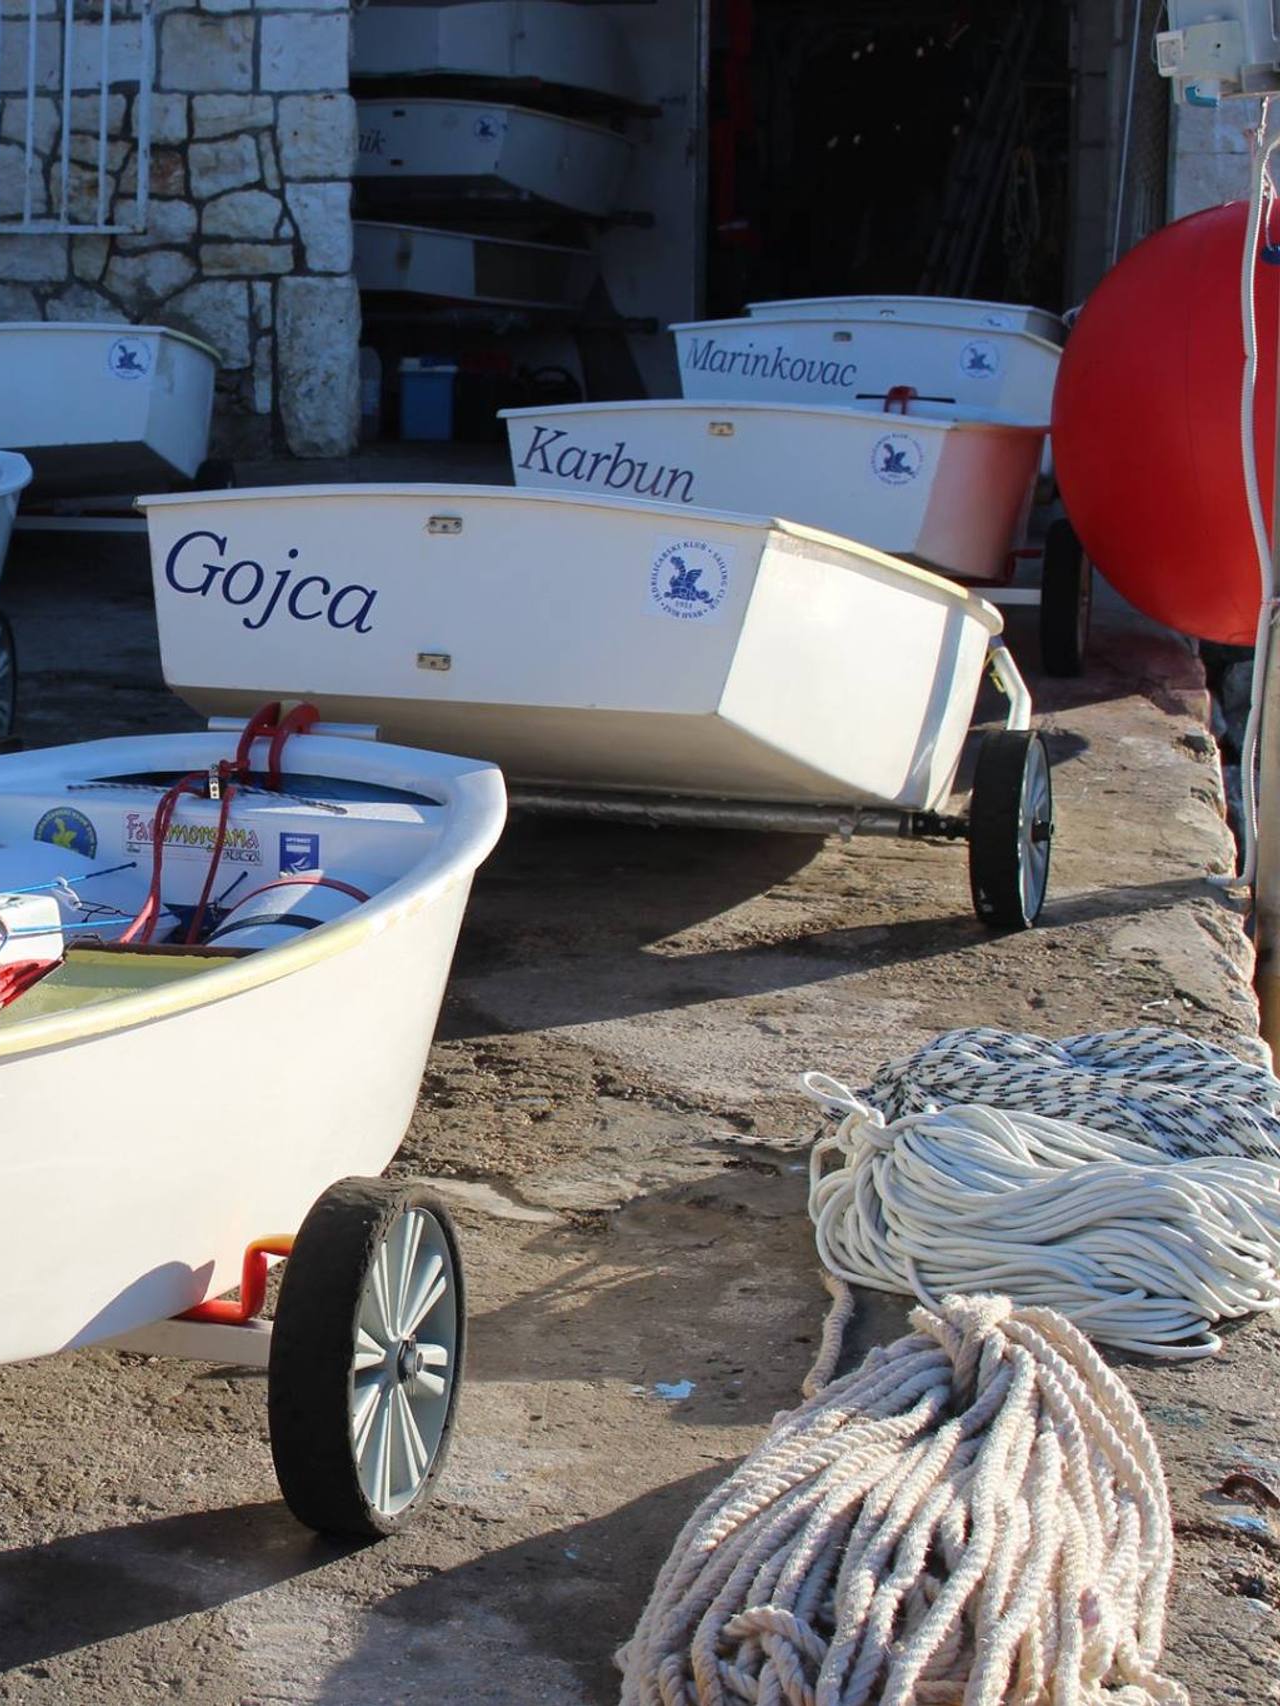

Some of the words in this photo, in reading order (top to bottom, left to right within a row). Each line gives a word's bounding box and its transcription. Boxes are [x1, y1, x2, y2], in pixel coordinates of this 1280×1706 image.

[686, 337, 858, 388] Marinkovac
[517, 424, 695, 504] Karbun
[165, 530, 379, 634] Gojca
